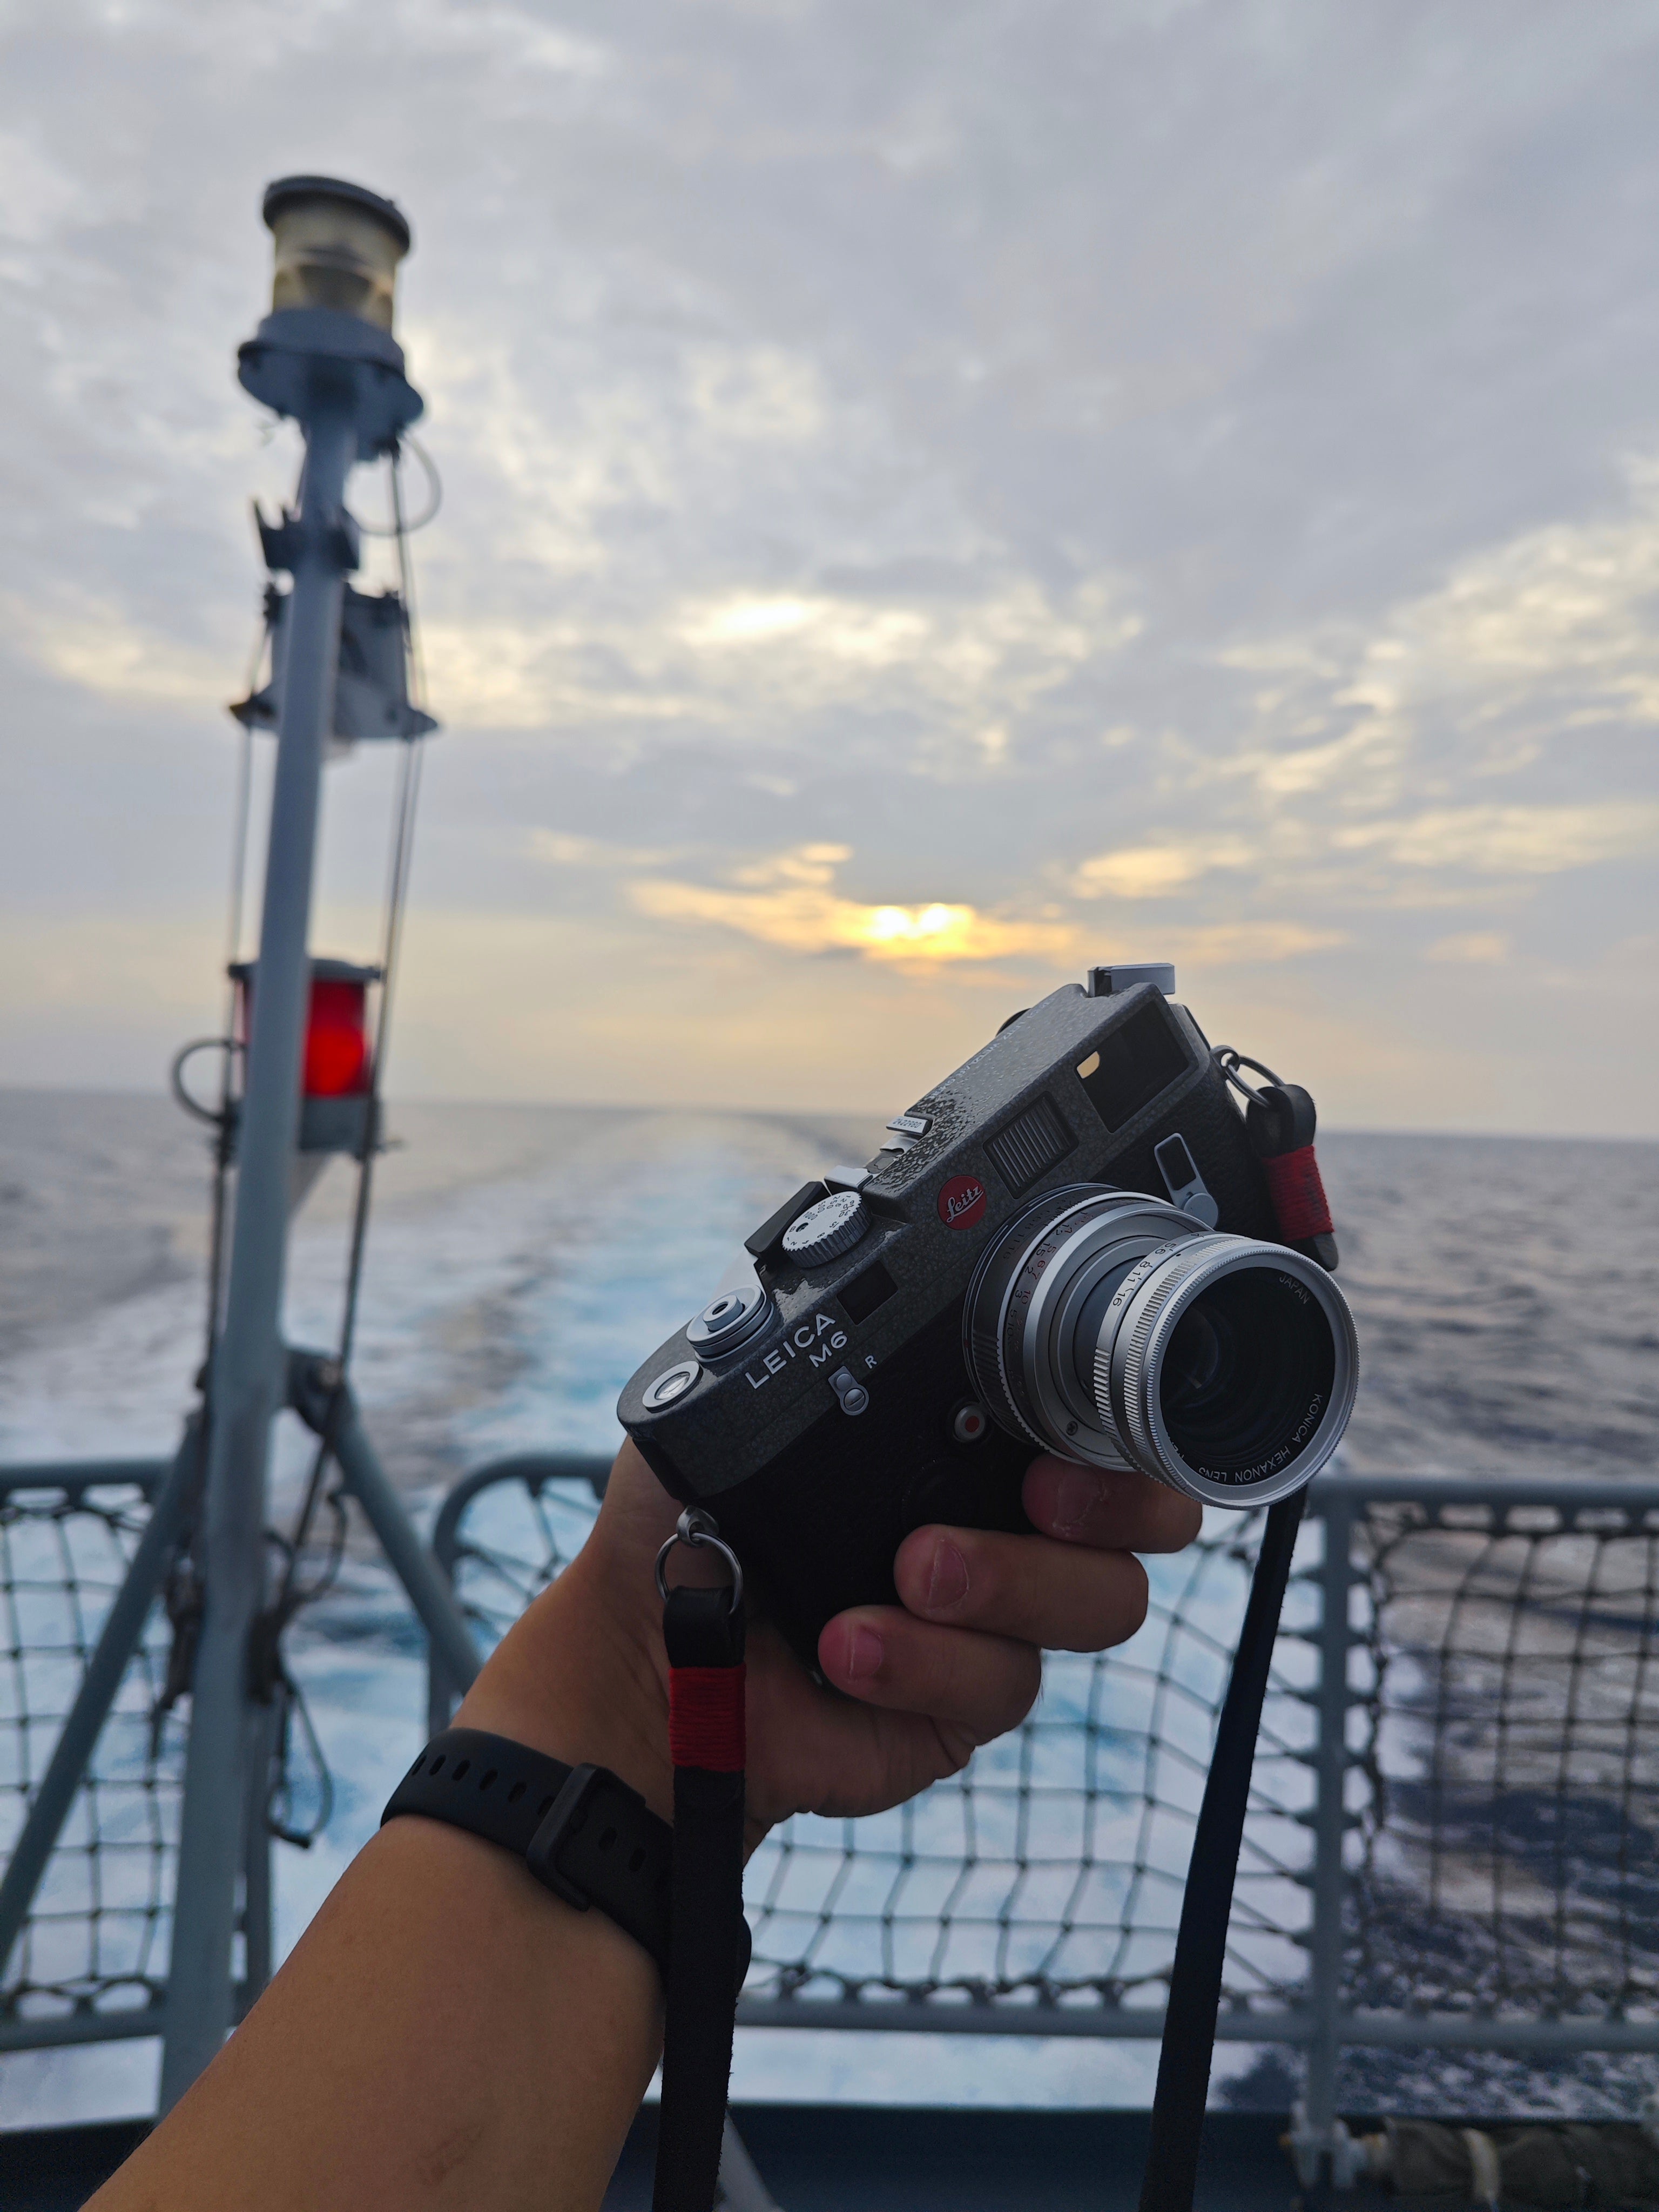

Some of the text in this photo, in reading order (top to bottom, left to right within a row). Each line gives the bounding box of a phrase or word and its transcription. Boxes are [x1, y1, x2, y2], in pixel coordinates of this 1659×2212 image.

[817, 1201, 826, 1213] 500
[843, 1200, 854, 1209] 60
[946, 1186, 983, 1223] Leitz
[803, 1211, 818, 1220] 1000
[1036, 1243, 1051, 1257] 1.5
[1047, 1245, 1057, 1253] 5
[1025, 1266, 1034, 1274] 2
[1037, 1260, 1046, 1268] 6
[1032, 1272, 1040, 1280] 7
[1127, 1272, 1141, 1282] 11
[1015, 1290, 1023, 1298] 3
[1279, 1274, 1310, 1305] JAPAN
[1022, 1290, 1031, 1304] 10
[1112, 1293, 1125, 1306] 16
[1010, 1309, 1017, 1318] 5
[745, 1313, 835, 1389] LEICA
[809, 1331, 847, 1367] M6
[865, 1355, 877, 1369] R
[1198, 1393, 1323, 1483] KONICA HEXANON LENS
